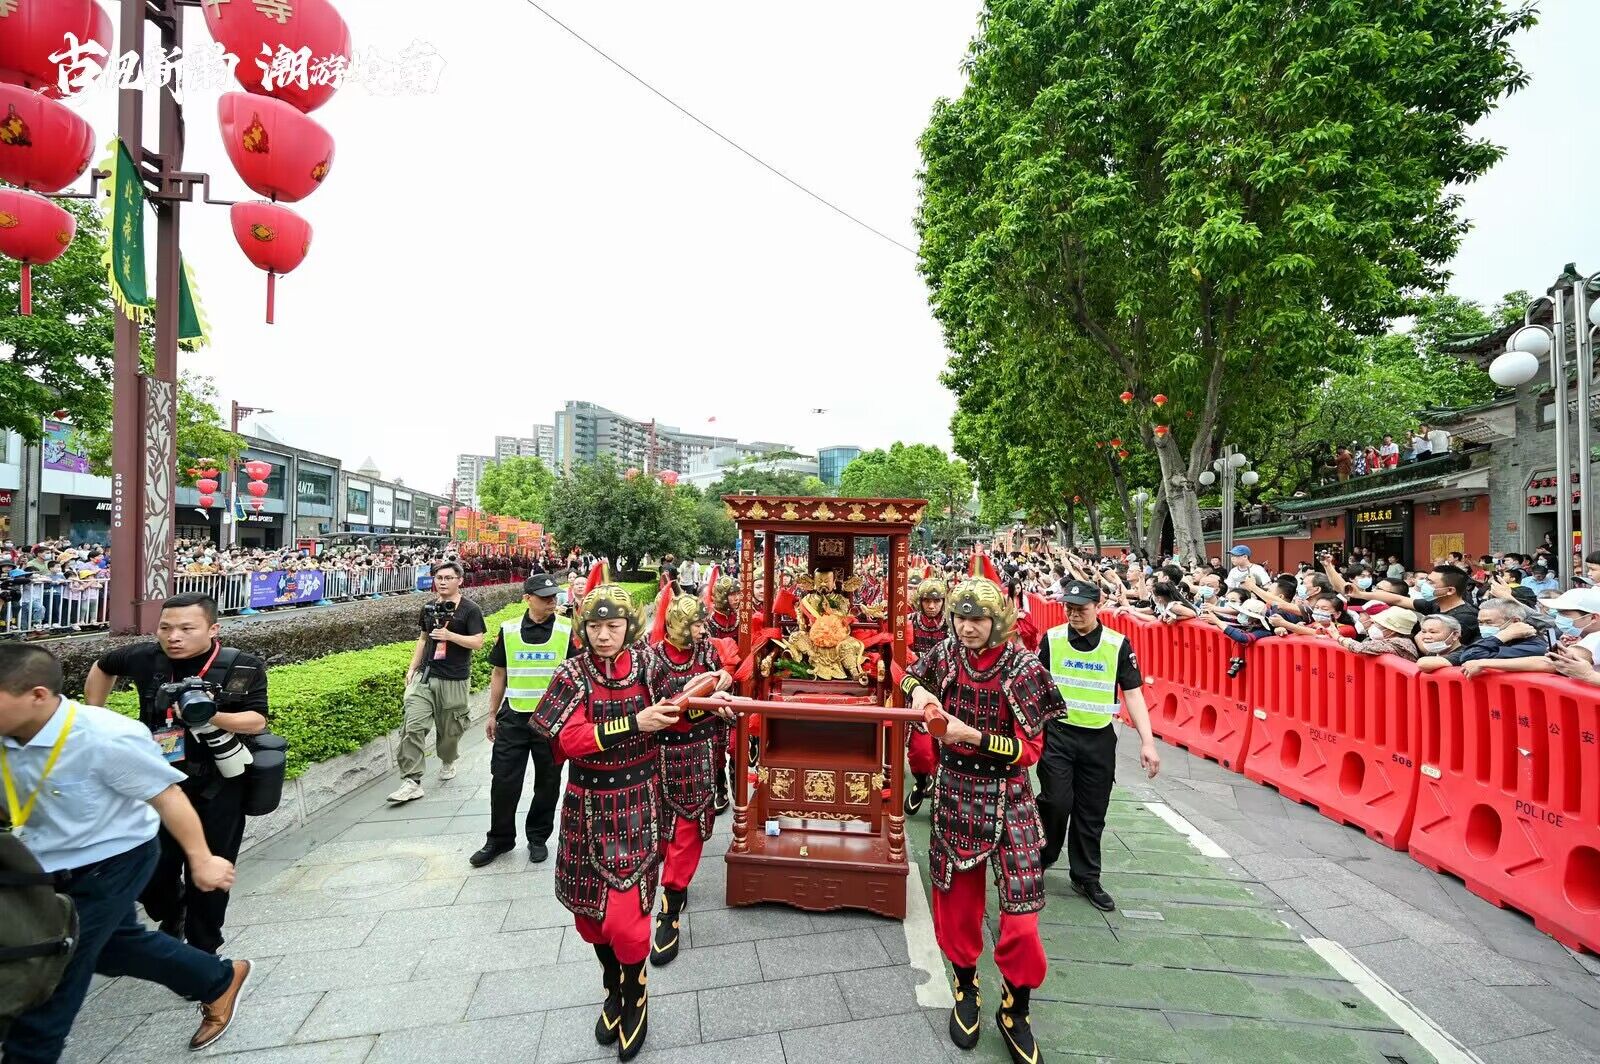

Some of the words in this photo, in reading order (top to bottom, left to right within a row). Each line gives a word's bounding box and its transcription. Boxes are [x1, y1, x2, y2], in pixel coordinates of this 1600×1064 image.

[298, 480, 315, 495] ANTA
[1064, 659, 1105, 672] 永高物业
[1490, 708, 1595, 745] 禅城公安
[1309, 728, 1337, 745] POLICE
[1391, 753, 1414, 769] 508
[1514, 799, 1564, 829] POLICE
